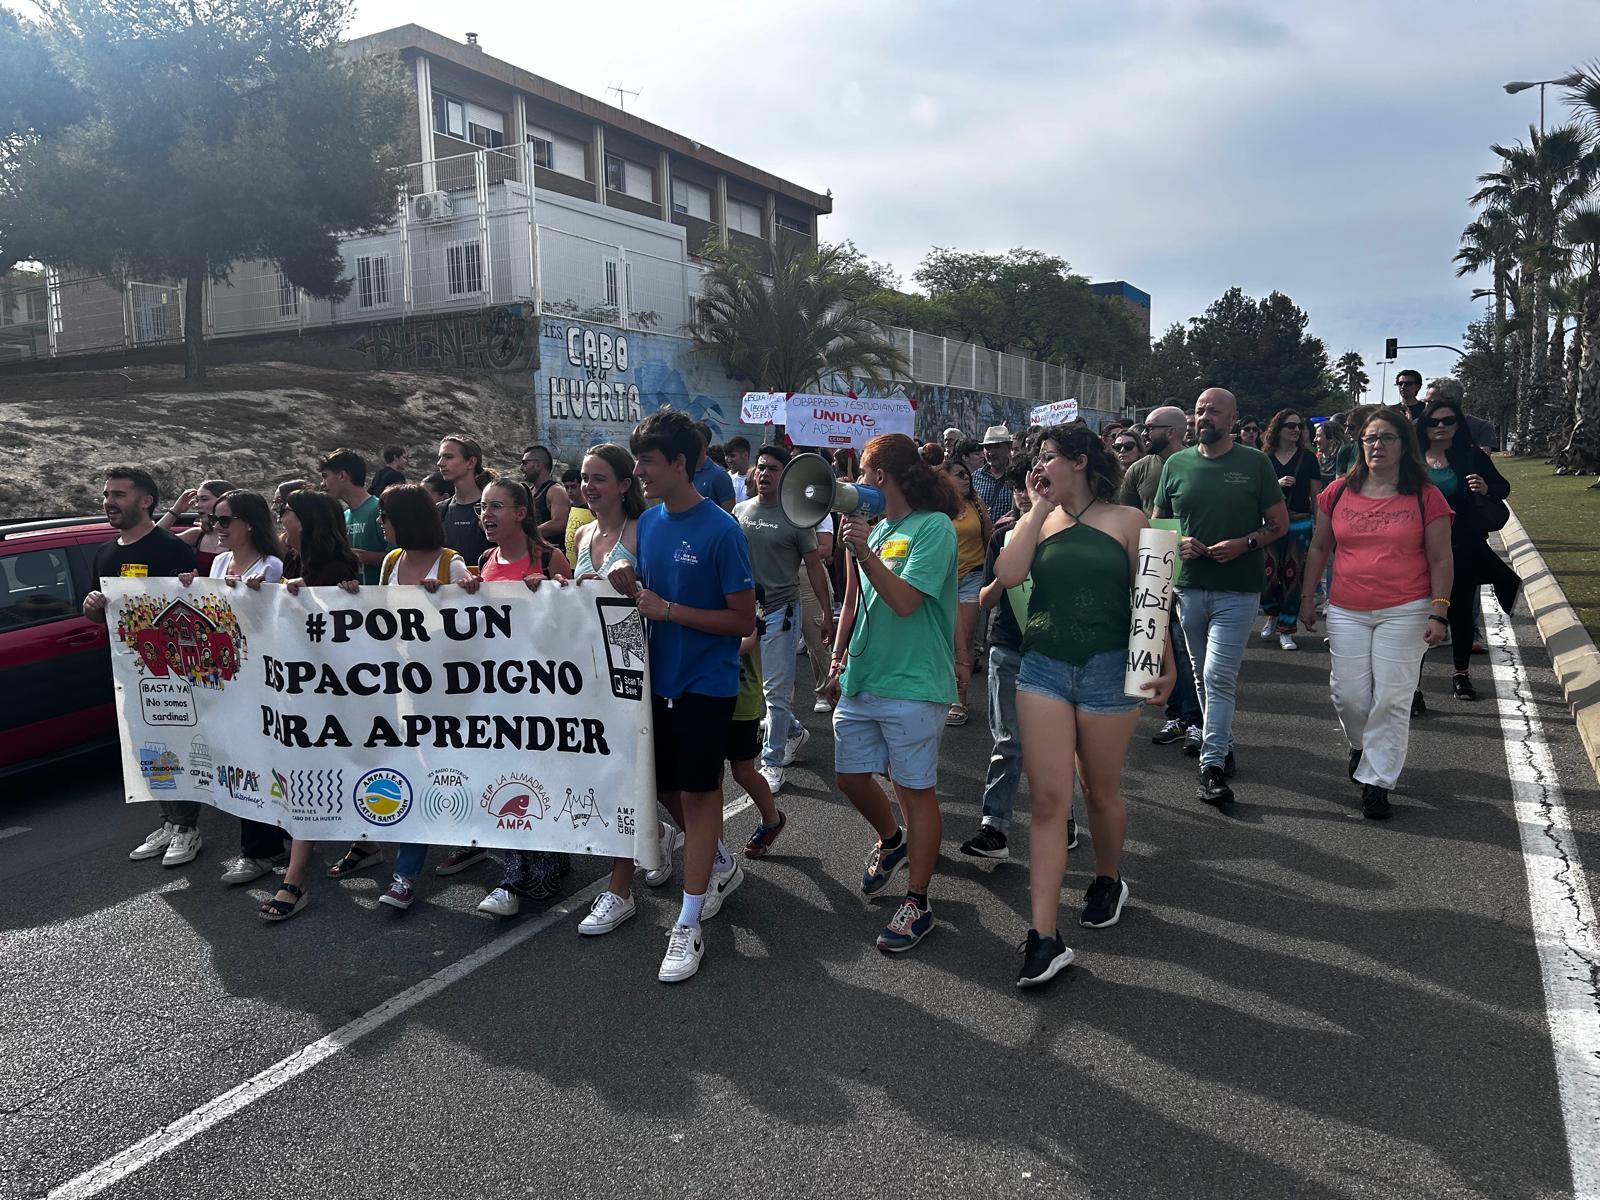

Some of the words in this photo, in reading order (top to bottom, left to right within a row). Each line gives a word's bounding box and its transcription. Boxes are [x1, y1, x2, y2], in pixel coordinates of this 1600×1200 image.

[566, 326, 629, 372] CABO
[586, 369, 597, 380] DE
[550, 376, 641, 422] HUERTA
[813, 408, 876, 427] UNIDAS
[813, 424, 881, 437] ADELANTE
[306, 607, 431, 643] #POR
[439, 604, 512, 641] UN
[262, 655, 433, 696] ESPACIO
[443, 659, 584, 696] DIGNO
[623, 675, 636, 686] Scan
[625, 685, 638, 695] Save
[164, 700, 188, 708] somos
[152, 712, 189, 722] sardinas!
[261, 705, 352, 748] PARA
[363, 713, 611, 756] APRENDER
[363, 773, 384, 788] AMPA
[433, 775, 463, 787] AMPA
[480, 784, 494, 808] CEIP
[496, 774, 507, 786] LA
[510, 771, 551, 811] ALMADRABA
[357, 798, 377, 821] PLATJA
[378, 815, 396, 823] SANT
[396, 799, 409, 820] JOAN
[496, 818, 533, 831] AMPA
